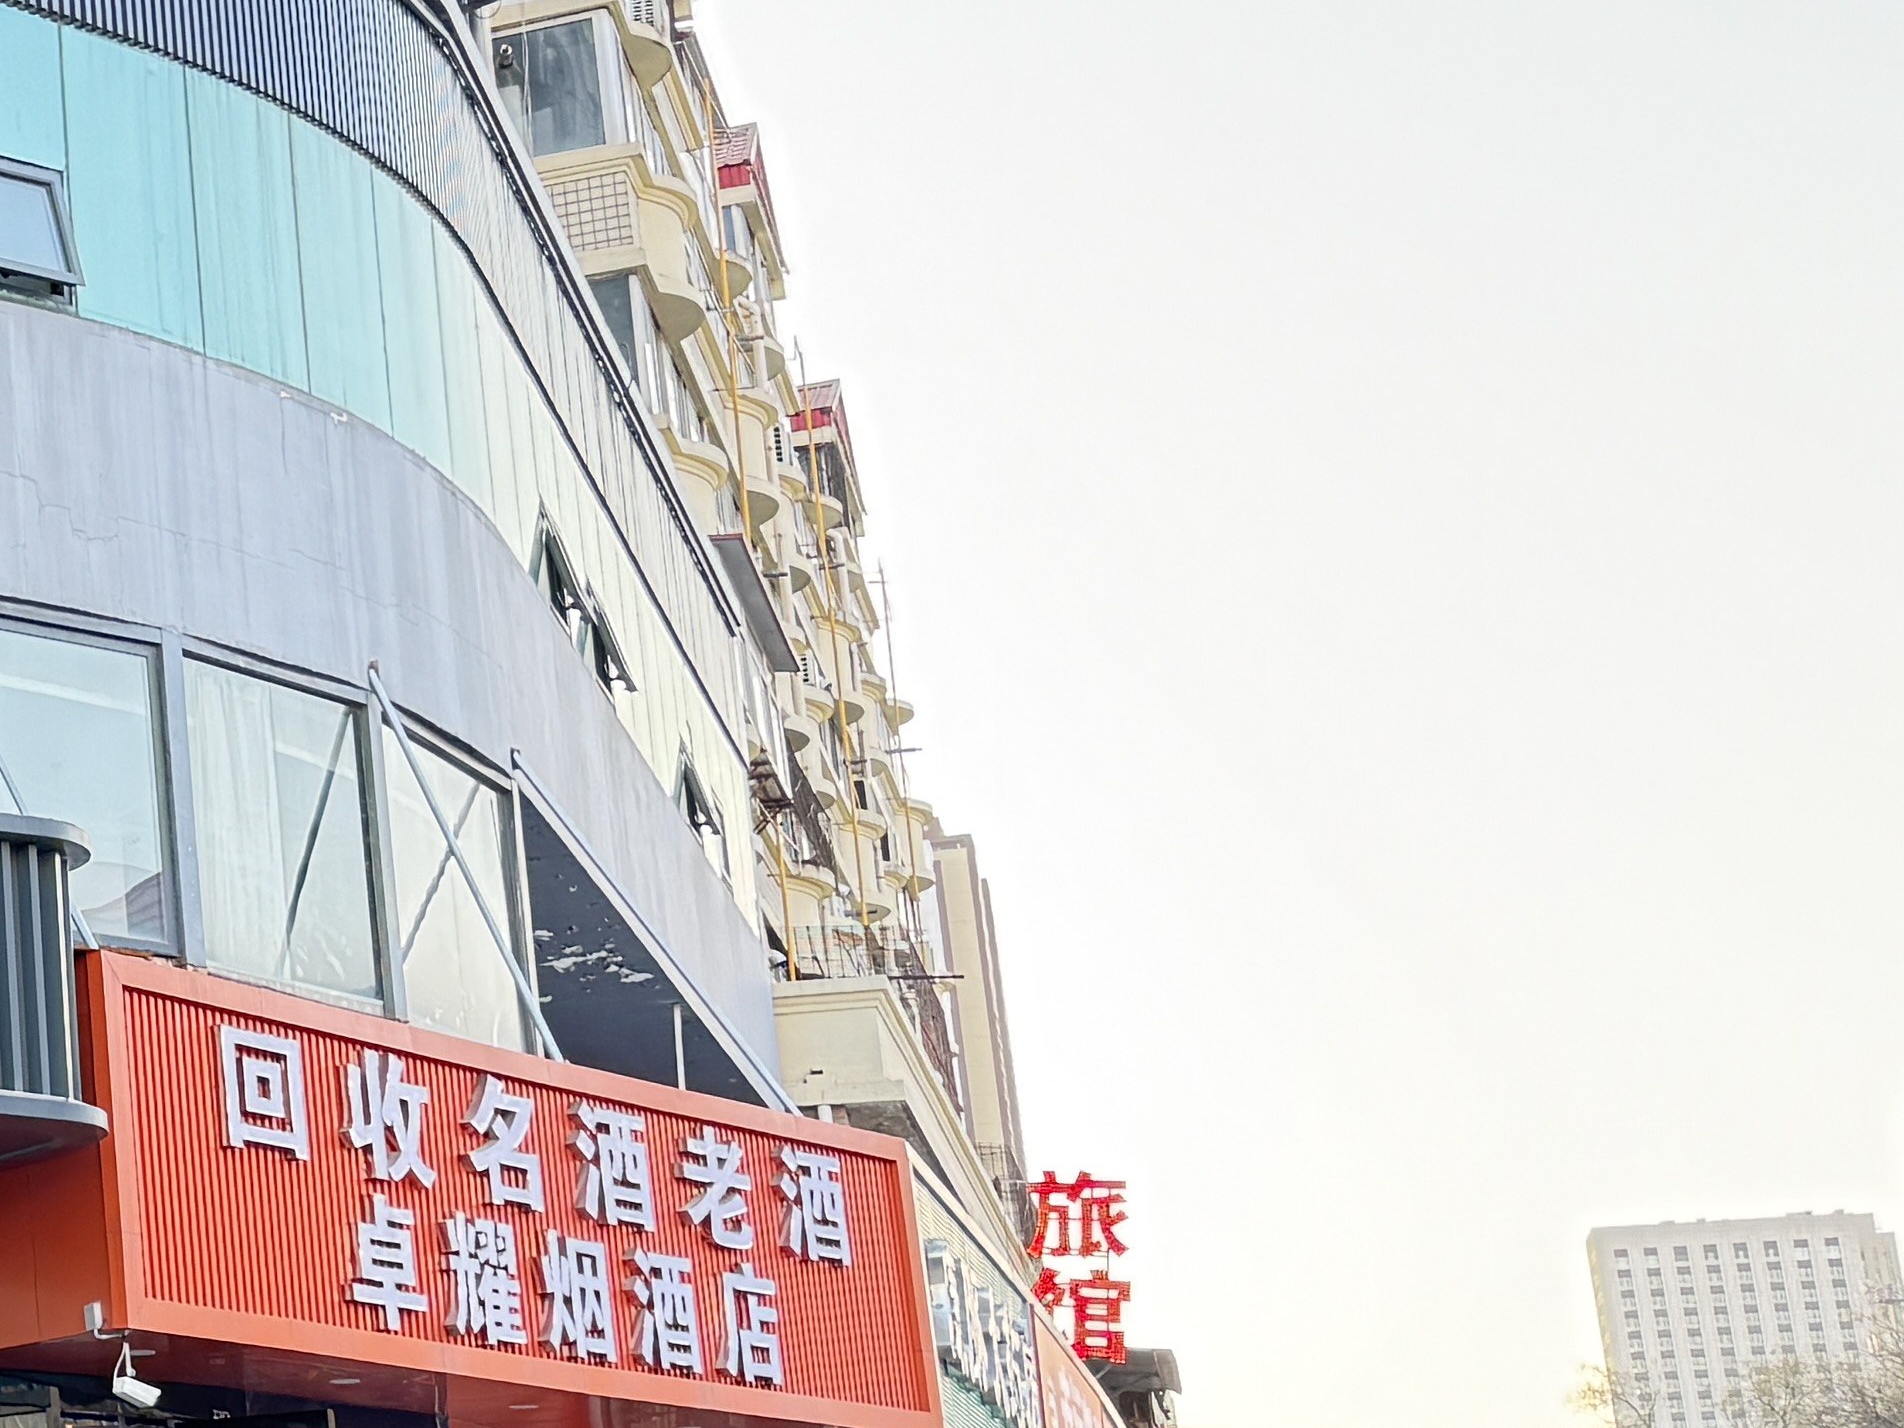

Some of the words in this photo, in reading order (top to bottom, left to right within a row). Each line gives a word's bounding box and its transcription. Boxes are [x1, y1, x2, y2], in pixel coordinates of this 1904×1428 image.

[216, 1023, 854, 1268] 回收名酒老酒
[352, 1194, 785, 1386] 卓耀烟酒店
[1026, 1170, 1130, 1364] 旅馆
